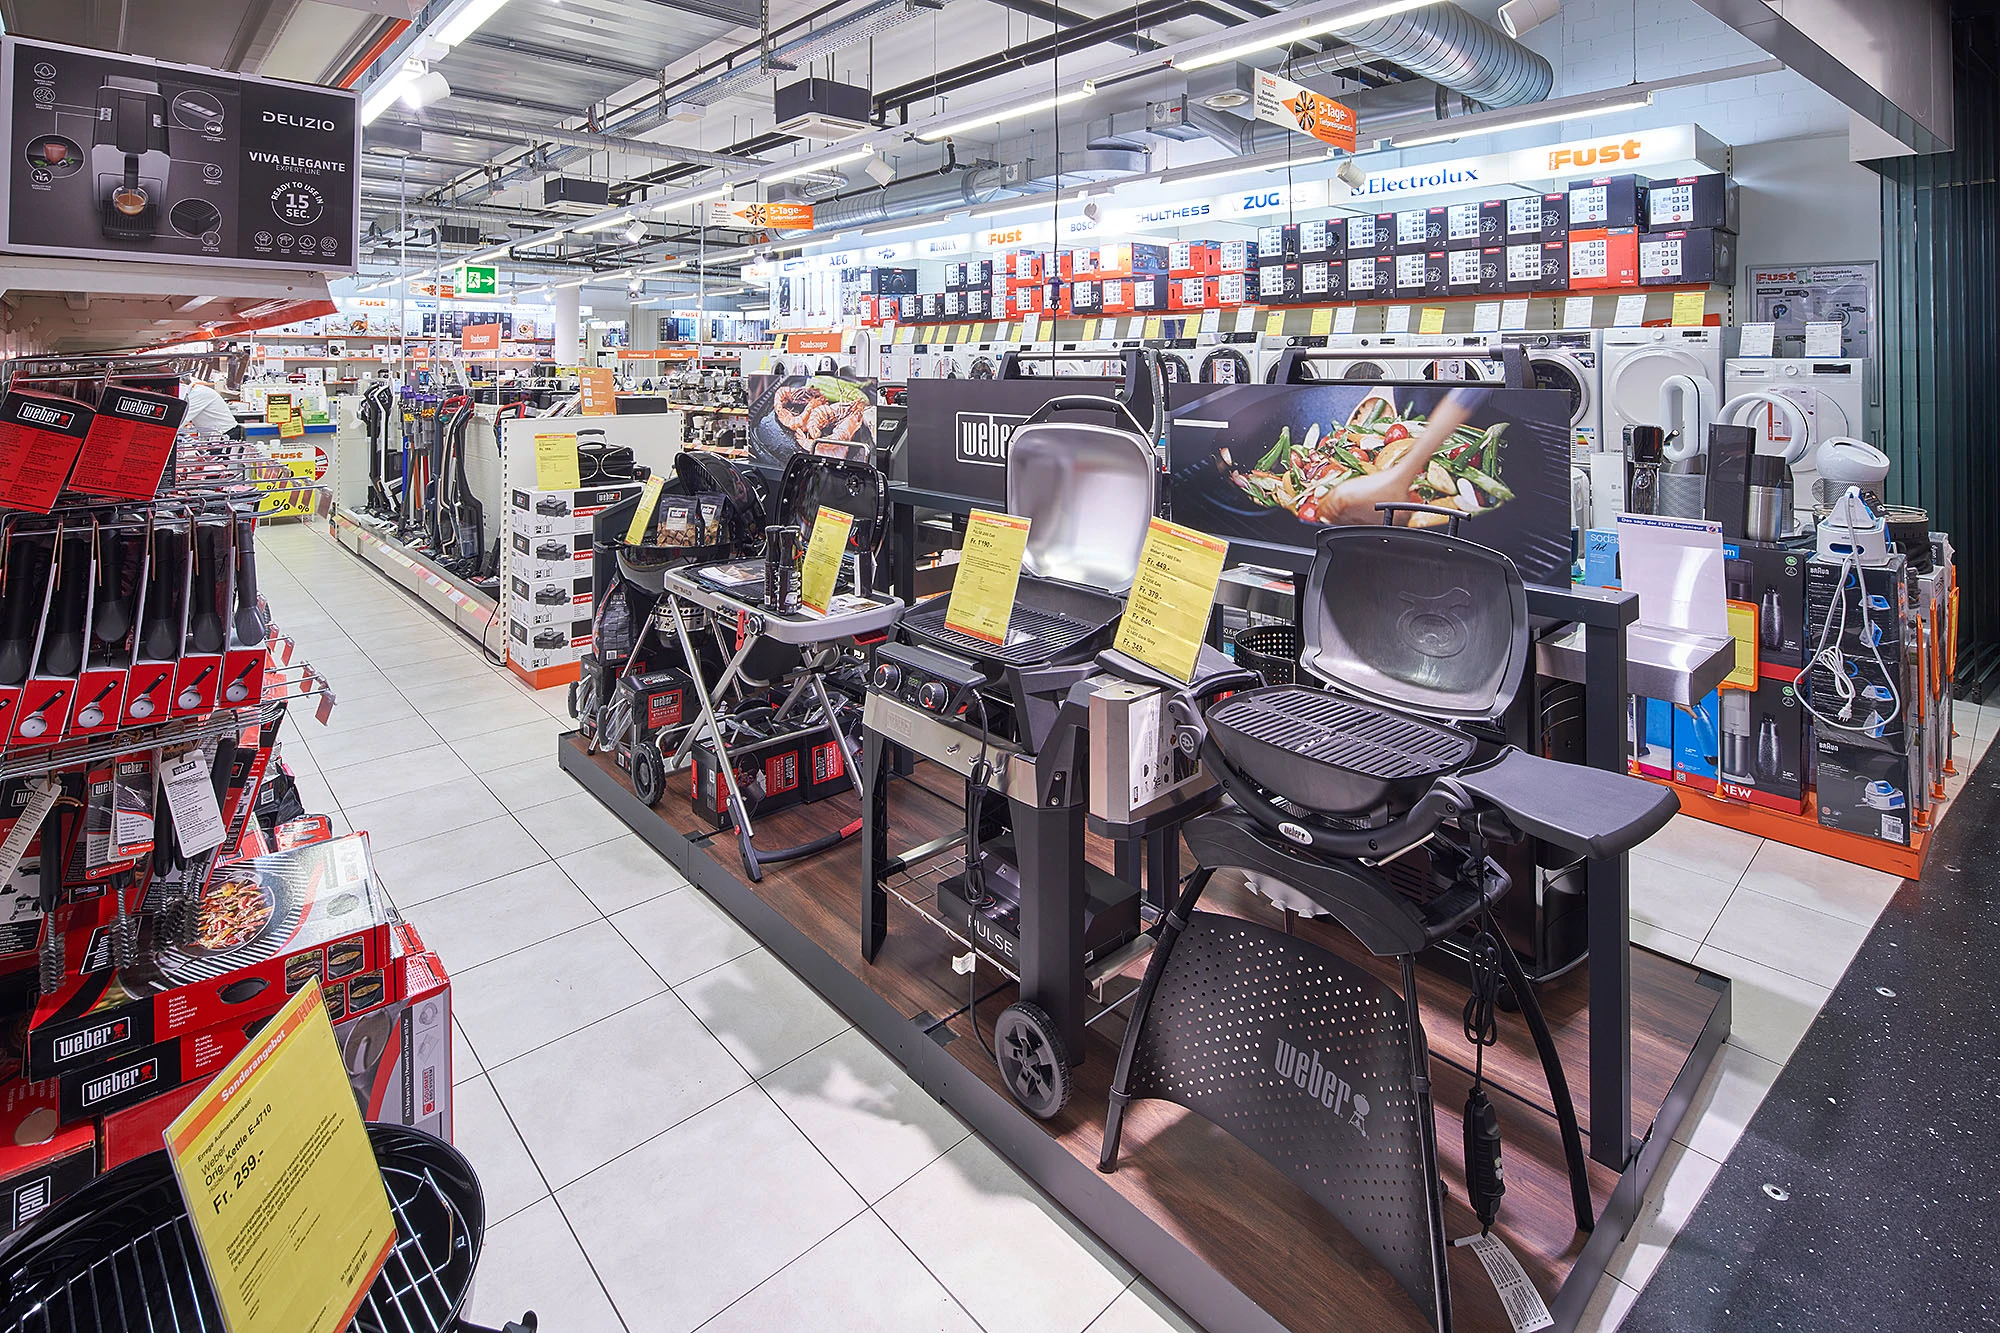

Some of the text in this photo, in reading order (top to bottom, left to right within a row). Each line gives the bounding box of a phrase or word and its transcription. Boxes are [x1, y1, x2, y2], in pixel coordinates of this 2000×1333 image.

[1262, 77, 1276, 86] Fust
[1319, 102, 1347, 122] 5-Tage-
[262, 111, 335, 131] DELIZIO
[249, 152, 346, 172] VIVA ELEGANTE
[1549, 139, 1641, 170] Fust
[276, 164, 321, 176] EXPERT LINE
[1368, 168, 1478, 195] Electrolux
[270, 182, 291, 201] READY
[304, 184, 318, 197] USE
[314, 192, 324, 204] IN
[286, 193, 309, 209] 15
[286, 208, 310, 219] SEC.
[1136, 204, 1210, 223] HULTHESS
[988, 229, 1022, 246] Fust
[828, 254, 848, 266] AEG
[1756, 272, 1797, 281] Fust
[800, 340, 829, 350] Staubsauger
[23, 405, 60, 423] weber
[121, 399, 154, 415] weber
[962, 416, 1016, 459] webe
[1590, 533, 1620, 544] sodas
[1146, 557, 1155, 566] Fr.
[1138, 586, 1147, 595] Fr.
[1122, 638, 1131, 647] Fr.
[121, 762, 143, 774] weber
[1723, 784, 1752, 799] NEW
[1282, 826, 1302, 842] weber
[59, 1026, 111, 1057] weber
[220, 1027, 286, 1102] Sonderangebot
[88, 1067, 138, 1100] weber
[1274, 1038, 1350, 1118] weber
[204, 1101, 272, 1188] Orig. Kettle E-4710
[201, 1143, 226, 1177] Weber
[212, 1144, 264, 1216] Fr. 259.-
